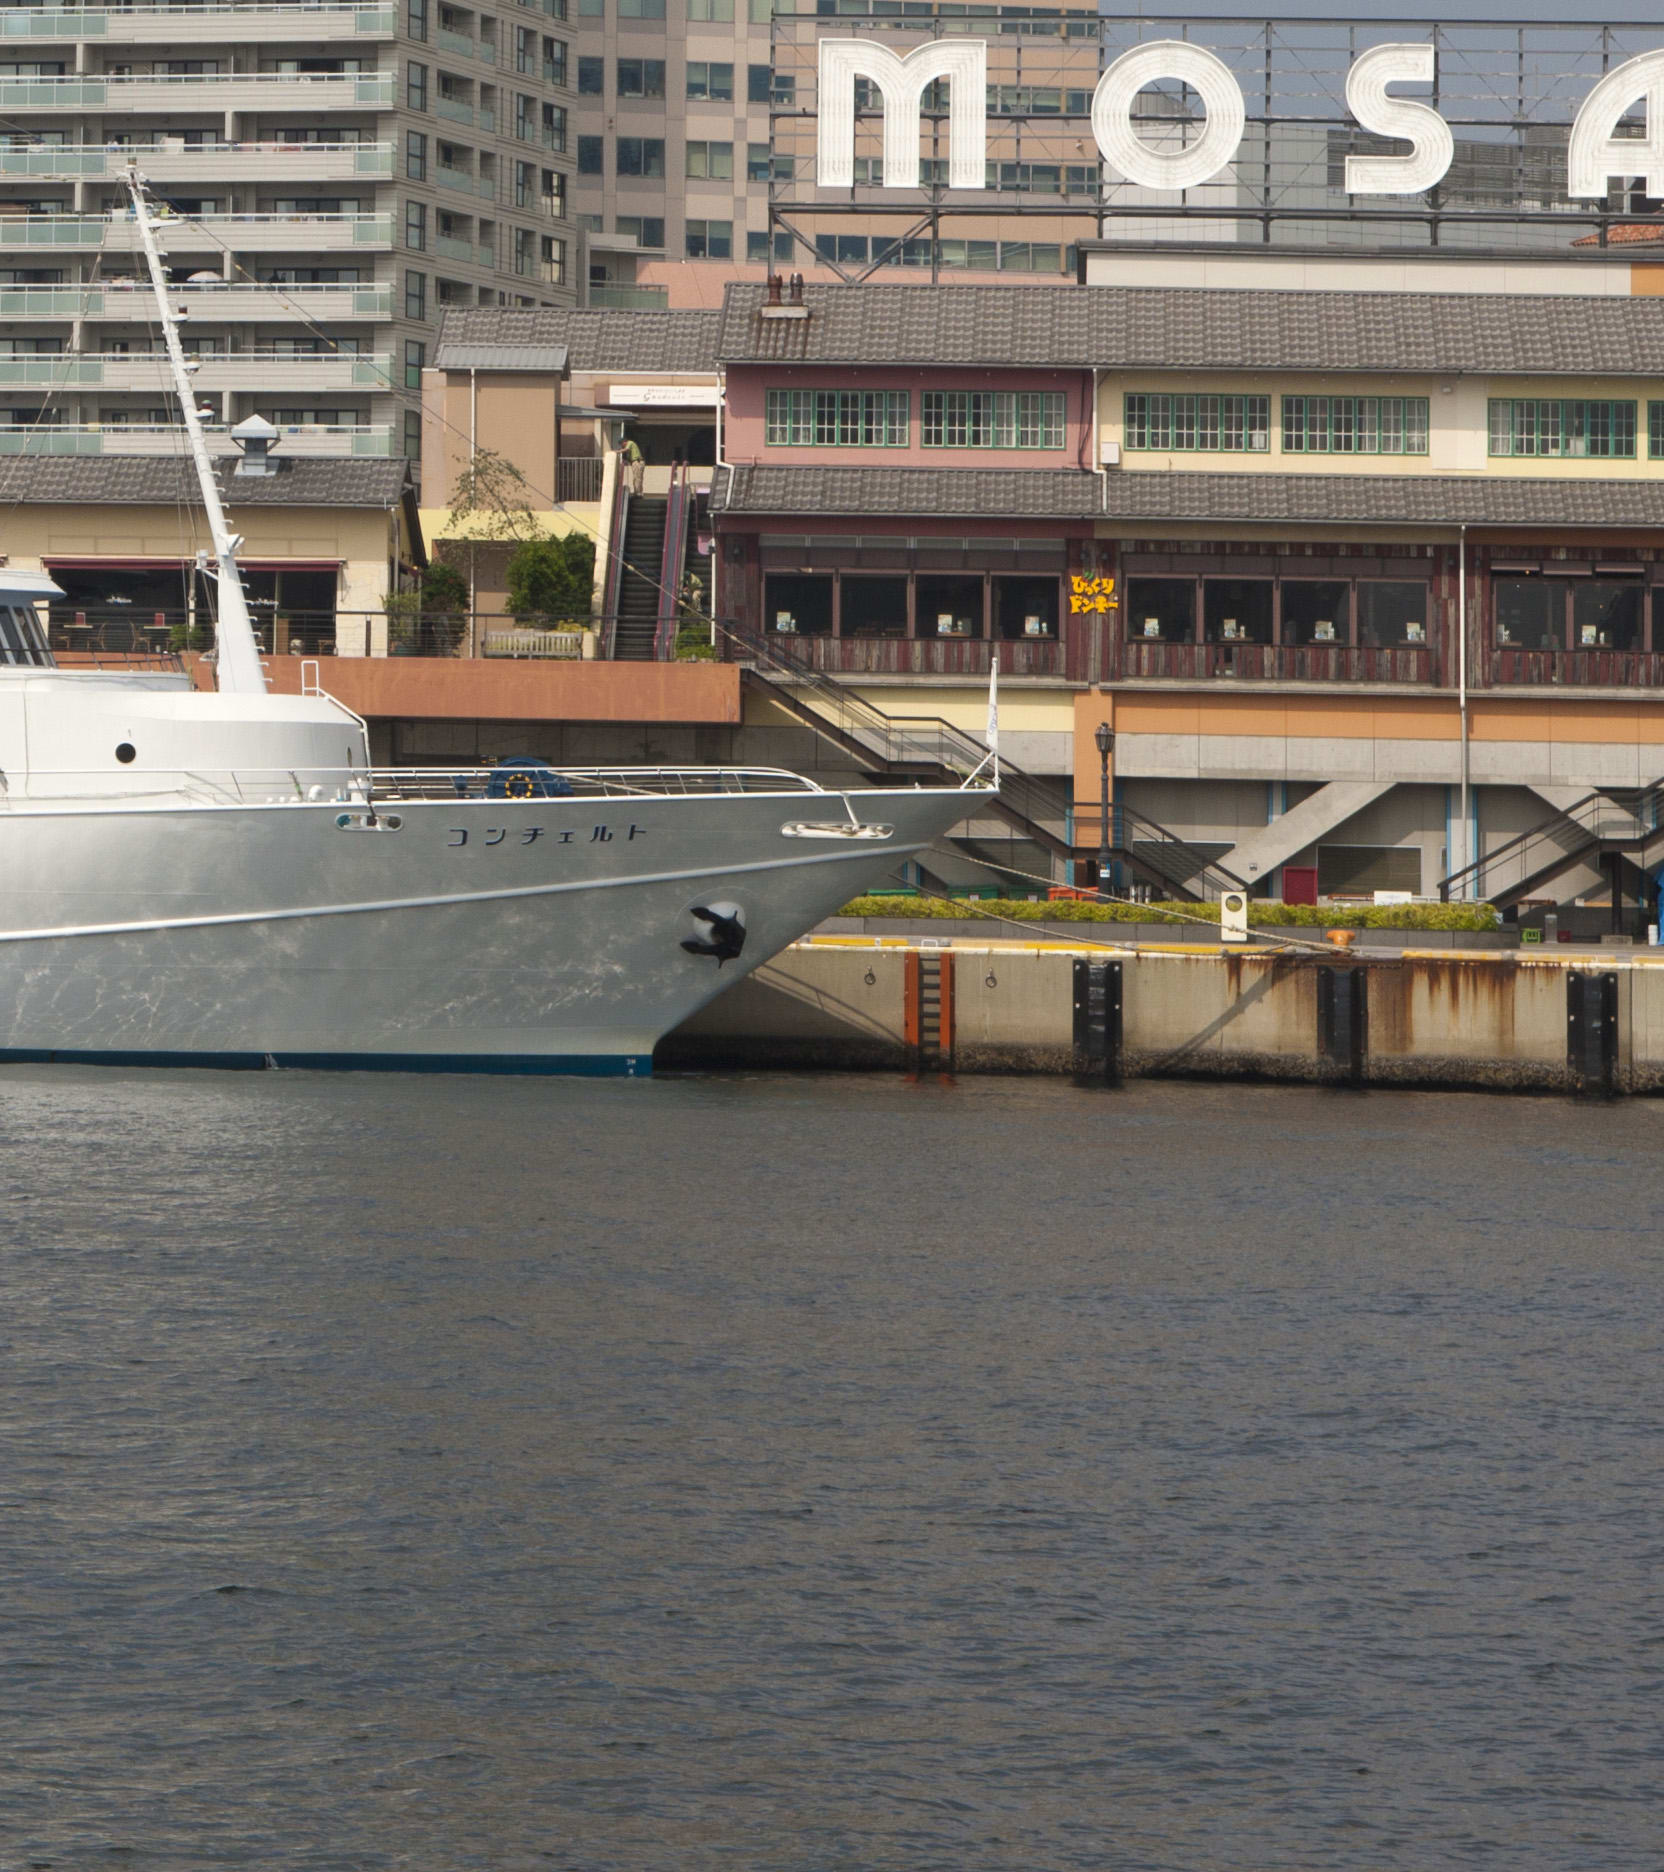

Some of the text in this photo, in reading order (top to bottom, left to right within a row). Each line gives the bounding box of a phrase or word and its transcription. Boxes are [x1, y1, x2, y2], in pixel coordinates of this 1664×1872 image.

[1071, 575, 1114, 595] びっくり
[1069, 594, 1119, 614] ドンキー
[447, 824, 647, 847] コンチェルト
